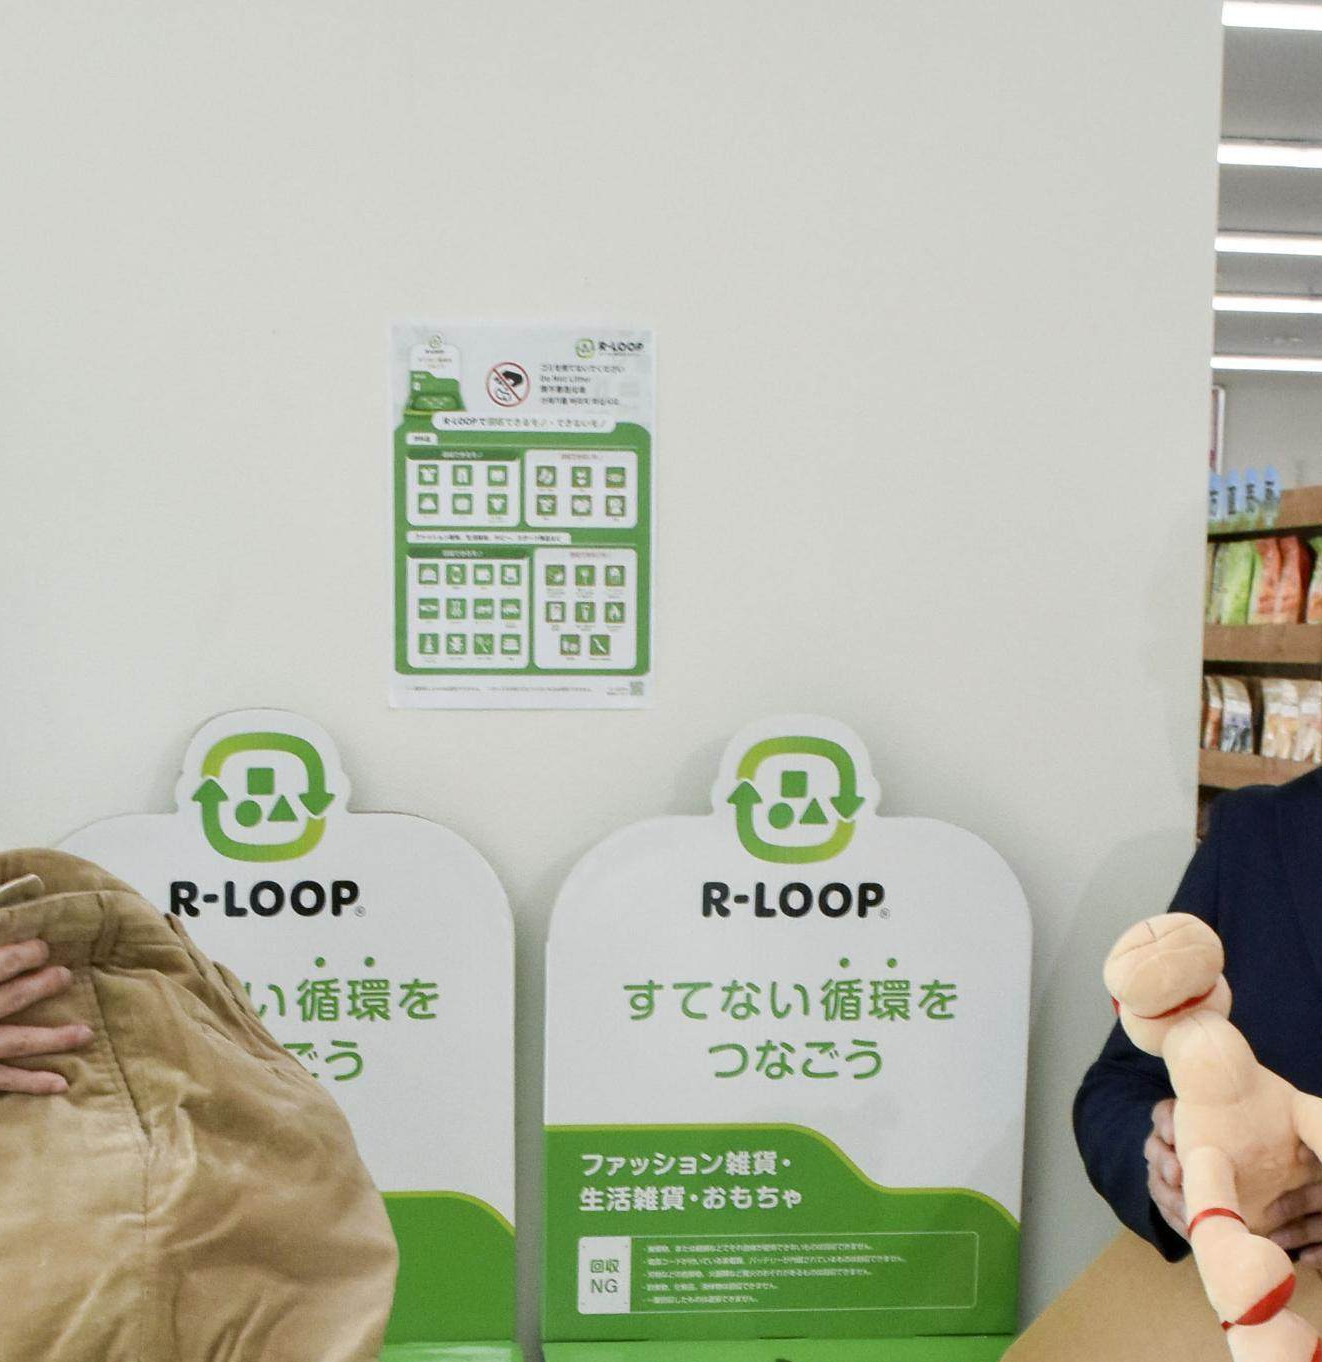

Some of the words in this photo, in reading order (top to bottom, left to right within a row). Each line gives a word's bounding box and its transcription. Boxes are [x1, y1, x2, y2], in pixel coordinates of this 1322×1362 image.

[169, 881, 360, 917] R-LOOP
[702, 882, 885, 918] R-LOOP
[623, 979, 957, 1022] すてない循環を
[708, 1039, 883, 1080] つなごう
[579, 1186, 803, 1212] 生活雑貨・おもちゃ
[590, 1259, 620, 1274] 回収
[590, 1279, 619, 1294] NG
